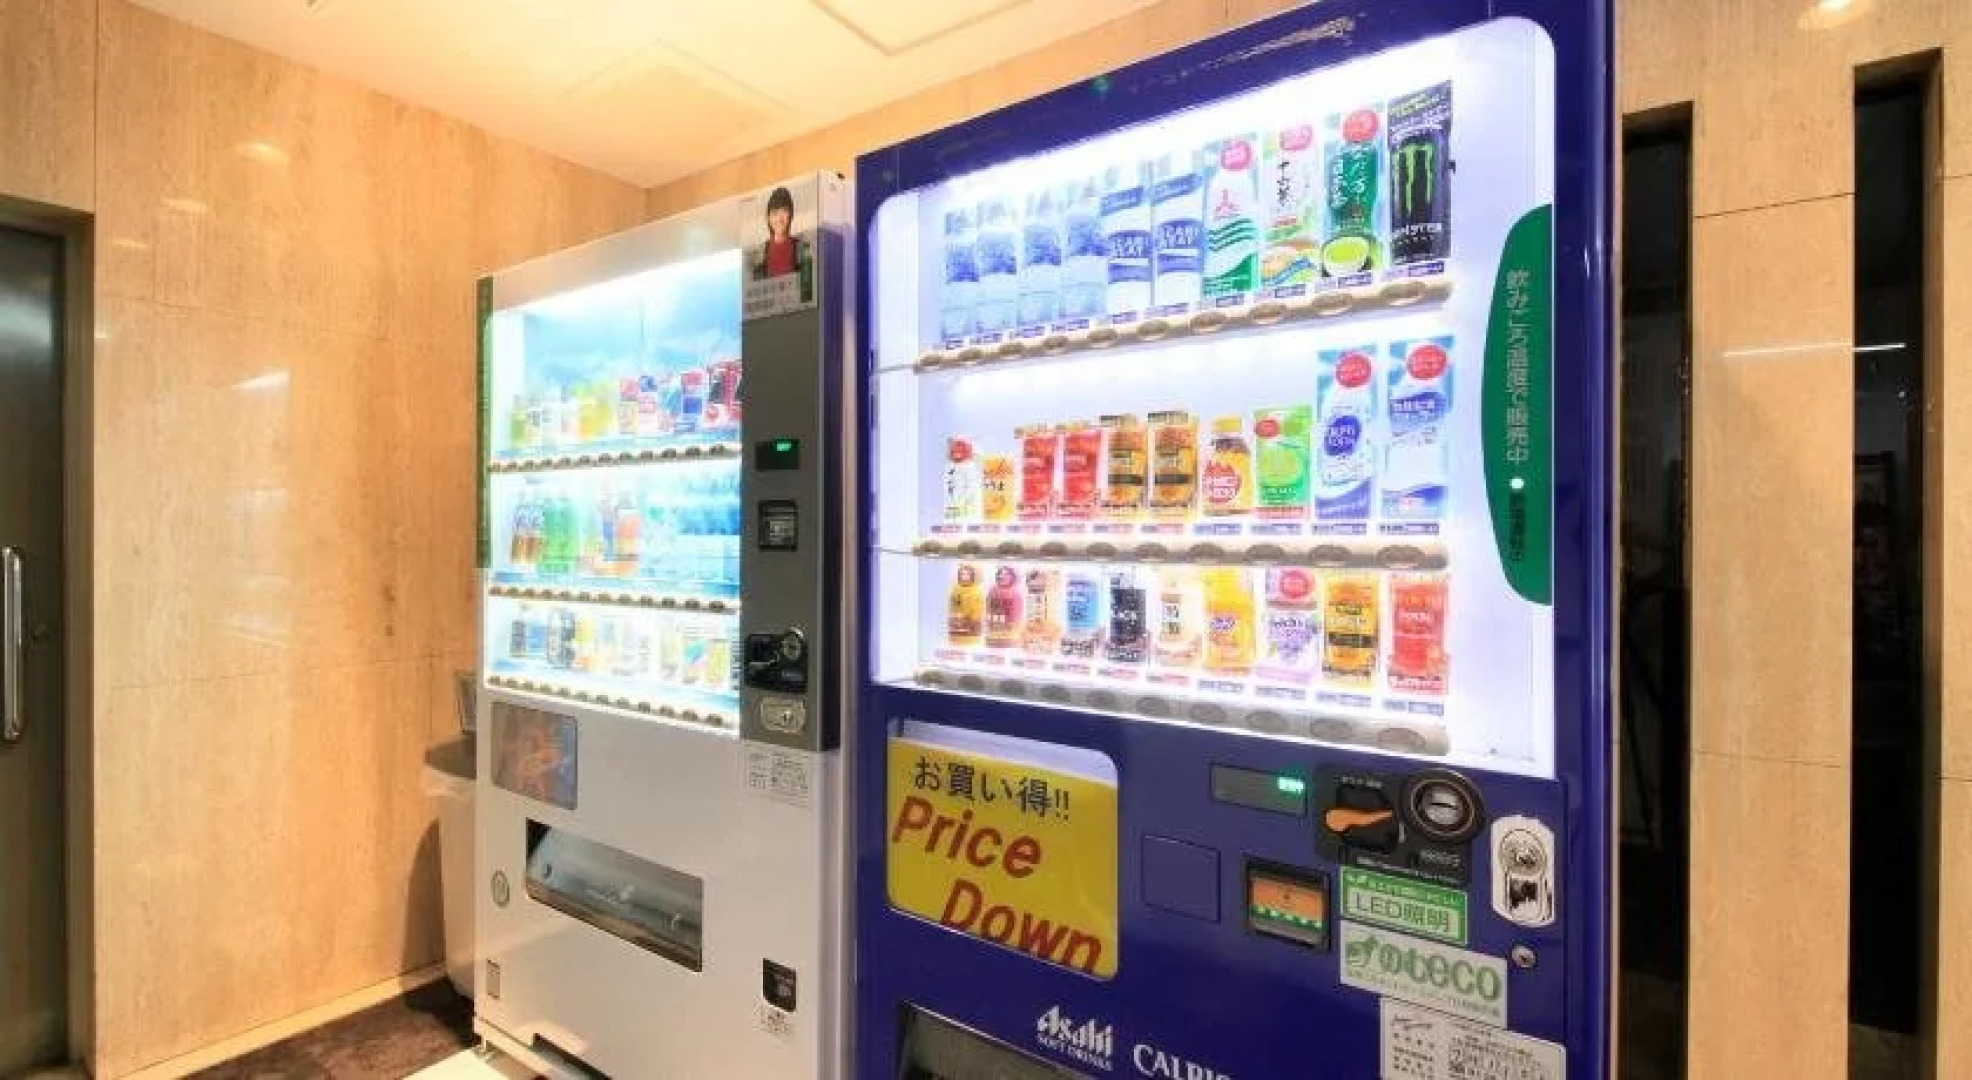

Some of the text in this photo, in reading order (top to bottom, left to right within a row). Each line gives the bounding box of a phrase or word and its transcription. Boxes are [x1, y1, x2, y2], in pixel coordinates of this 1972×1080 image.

[892, 795, 1042, 878] Price
[939, 878, 1102, 974] Down
[1037, 1004, 1114, 1057] Asahi
